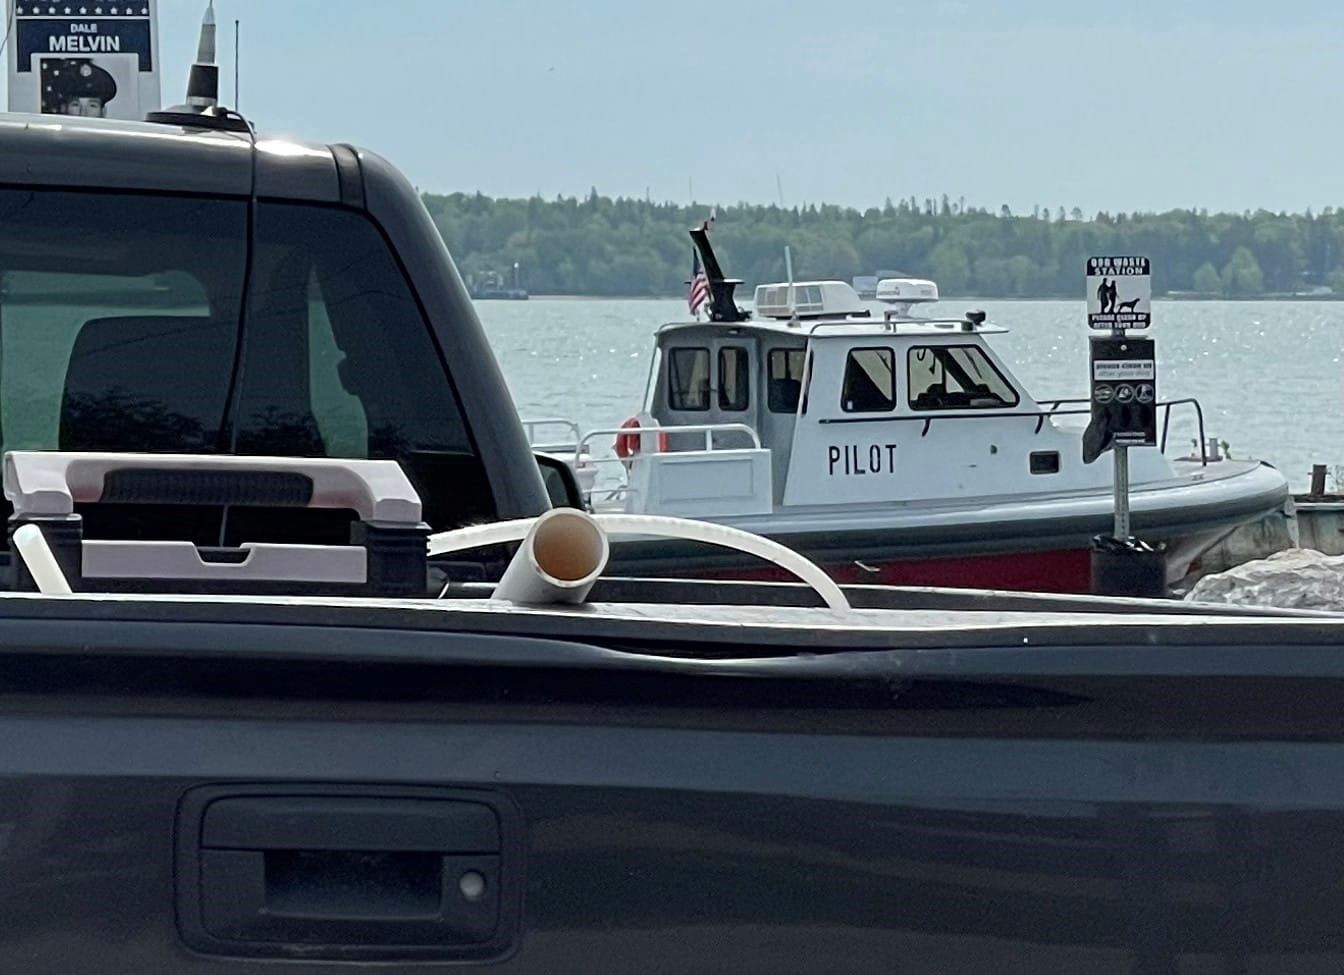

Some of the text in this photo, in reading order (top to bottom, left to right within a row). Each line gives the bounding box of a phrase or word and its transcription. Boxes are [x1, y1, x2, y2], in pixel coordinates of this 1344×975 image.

[70, 23, 97, 33] DALE
[48, 35, 120, 52] MELVIN
[1094, 267, 1143, 275] STATION
[828, 443, 897, 476] PILOT
